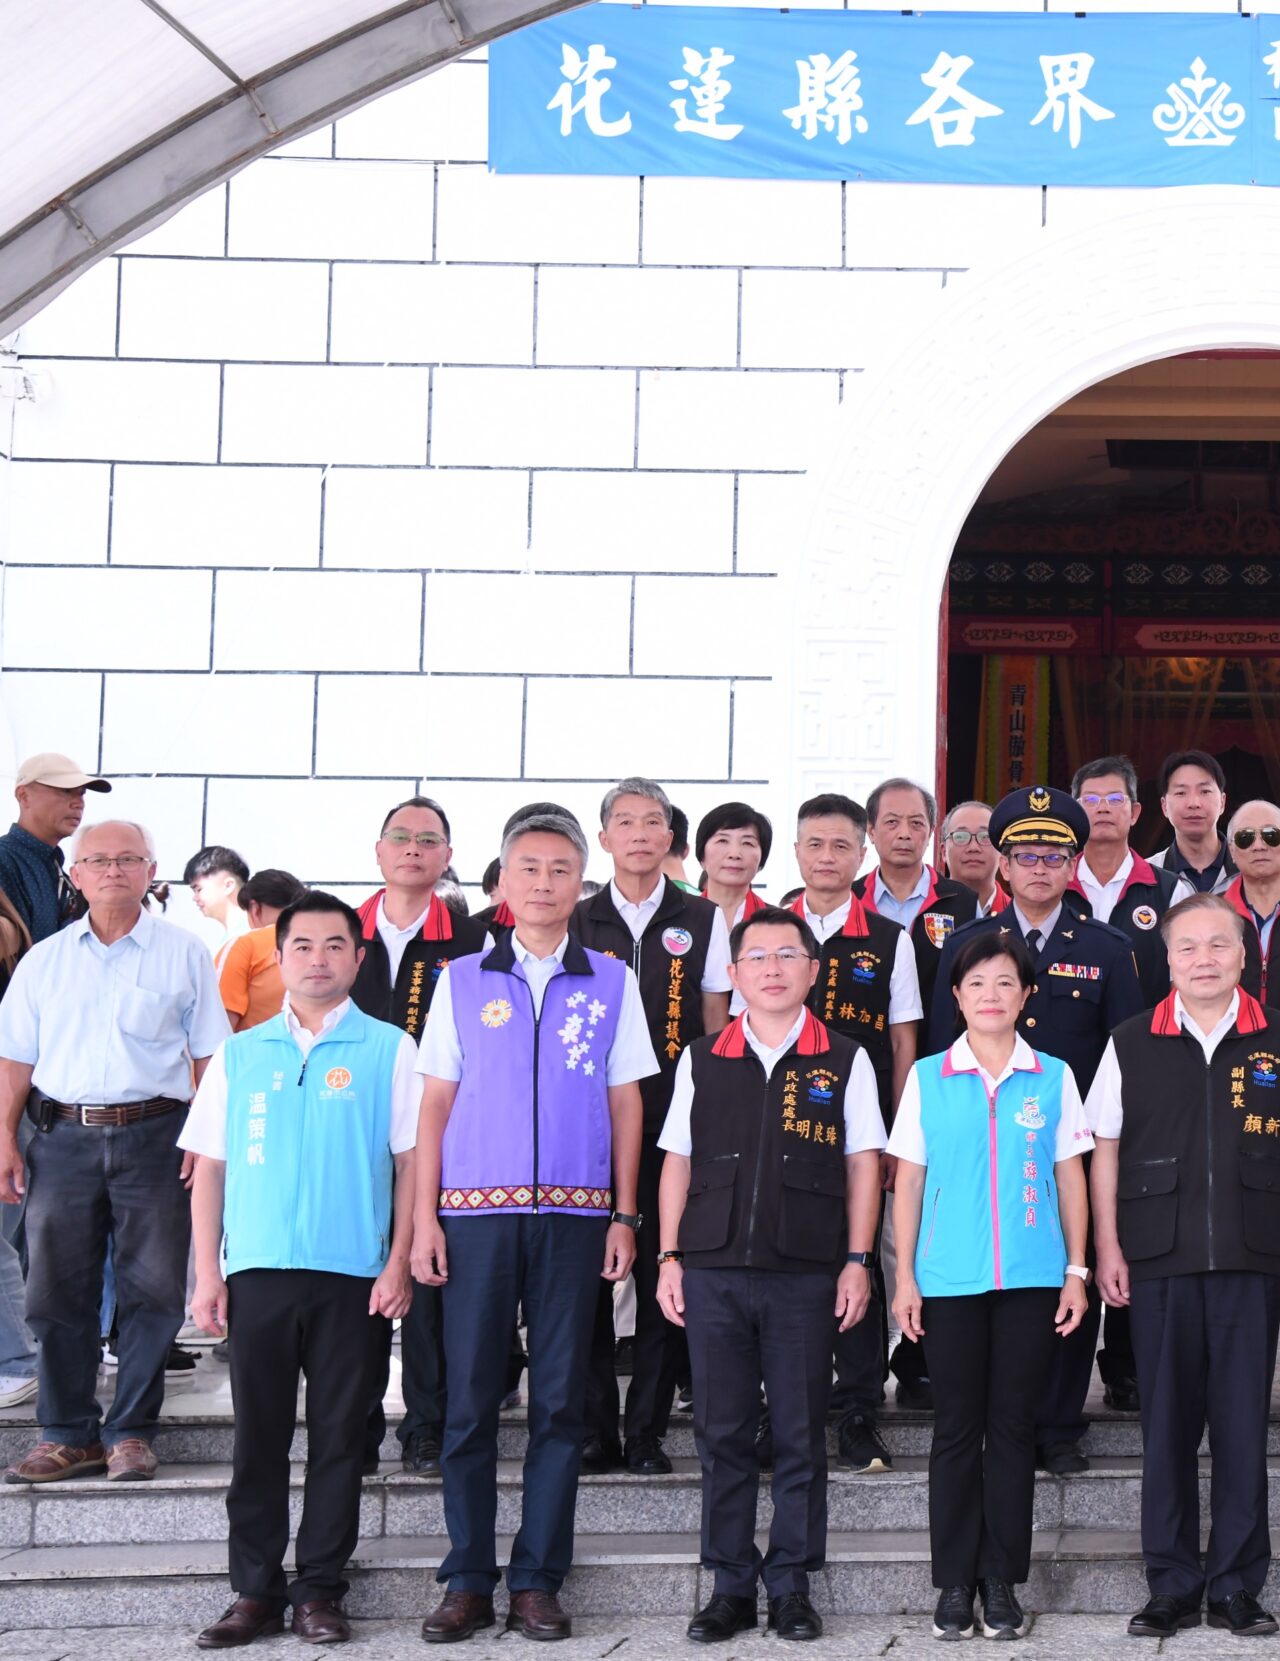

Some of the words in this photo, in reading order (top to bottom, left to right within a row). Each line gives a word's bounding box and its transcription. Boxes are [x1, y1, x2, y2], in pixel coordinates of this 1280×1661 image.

[546, 41, 1116, 149] 花蓮縣各界
[1008, 684, 1026, 791] 青山傲骨
[665, 959, 684, 1059] 花蓮縣議會
[781, 1070, 800, 1131] 民政處處長
[1230, 1066, 1246, 1109] 副縣長
[795, 1119, 838, 1146] 明良臻
